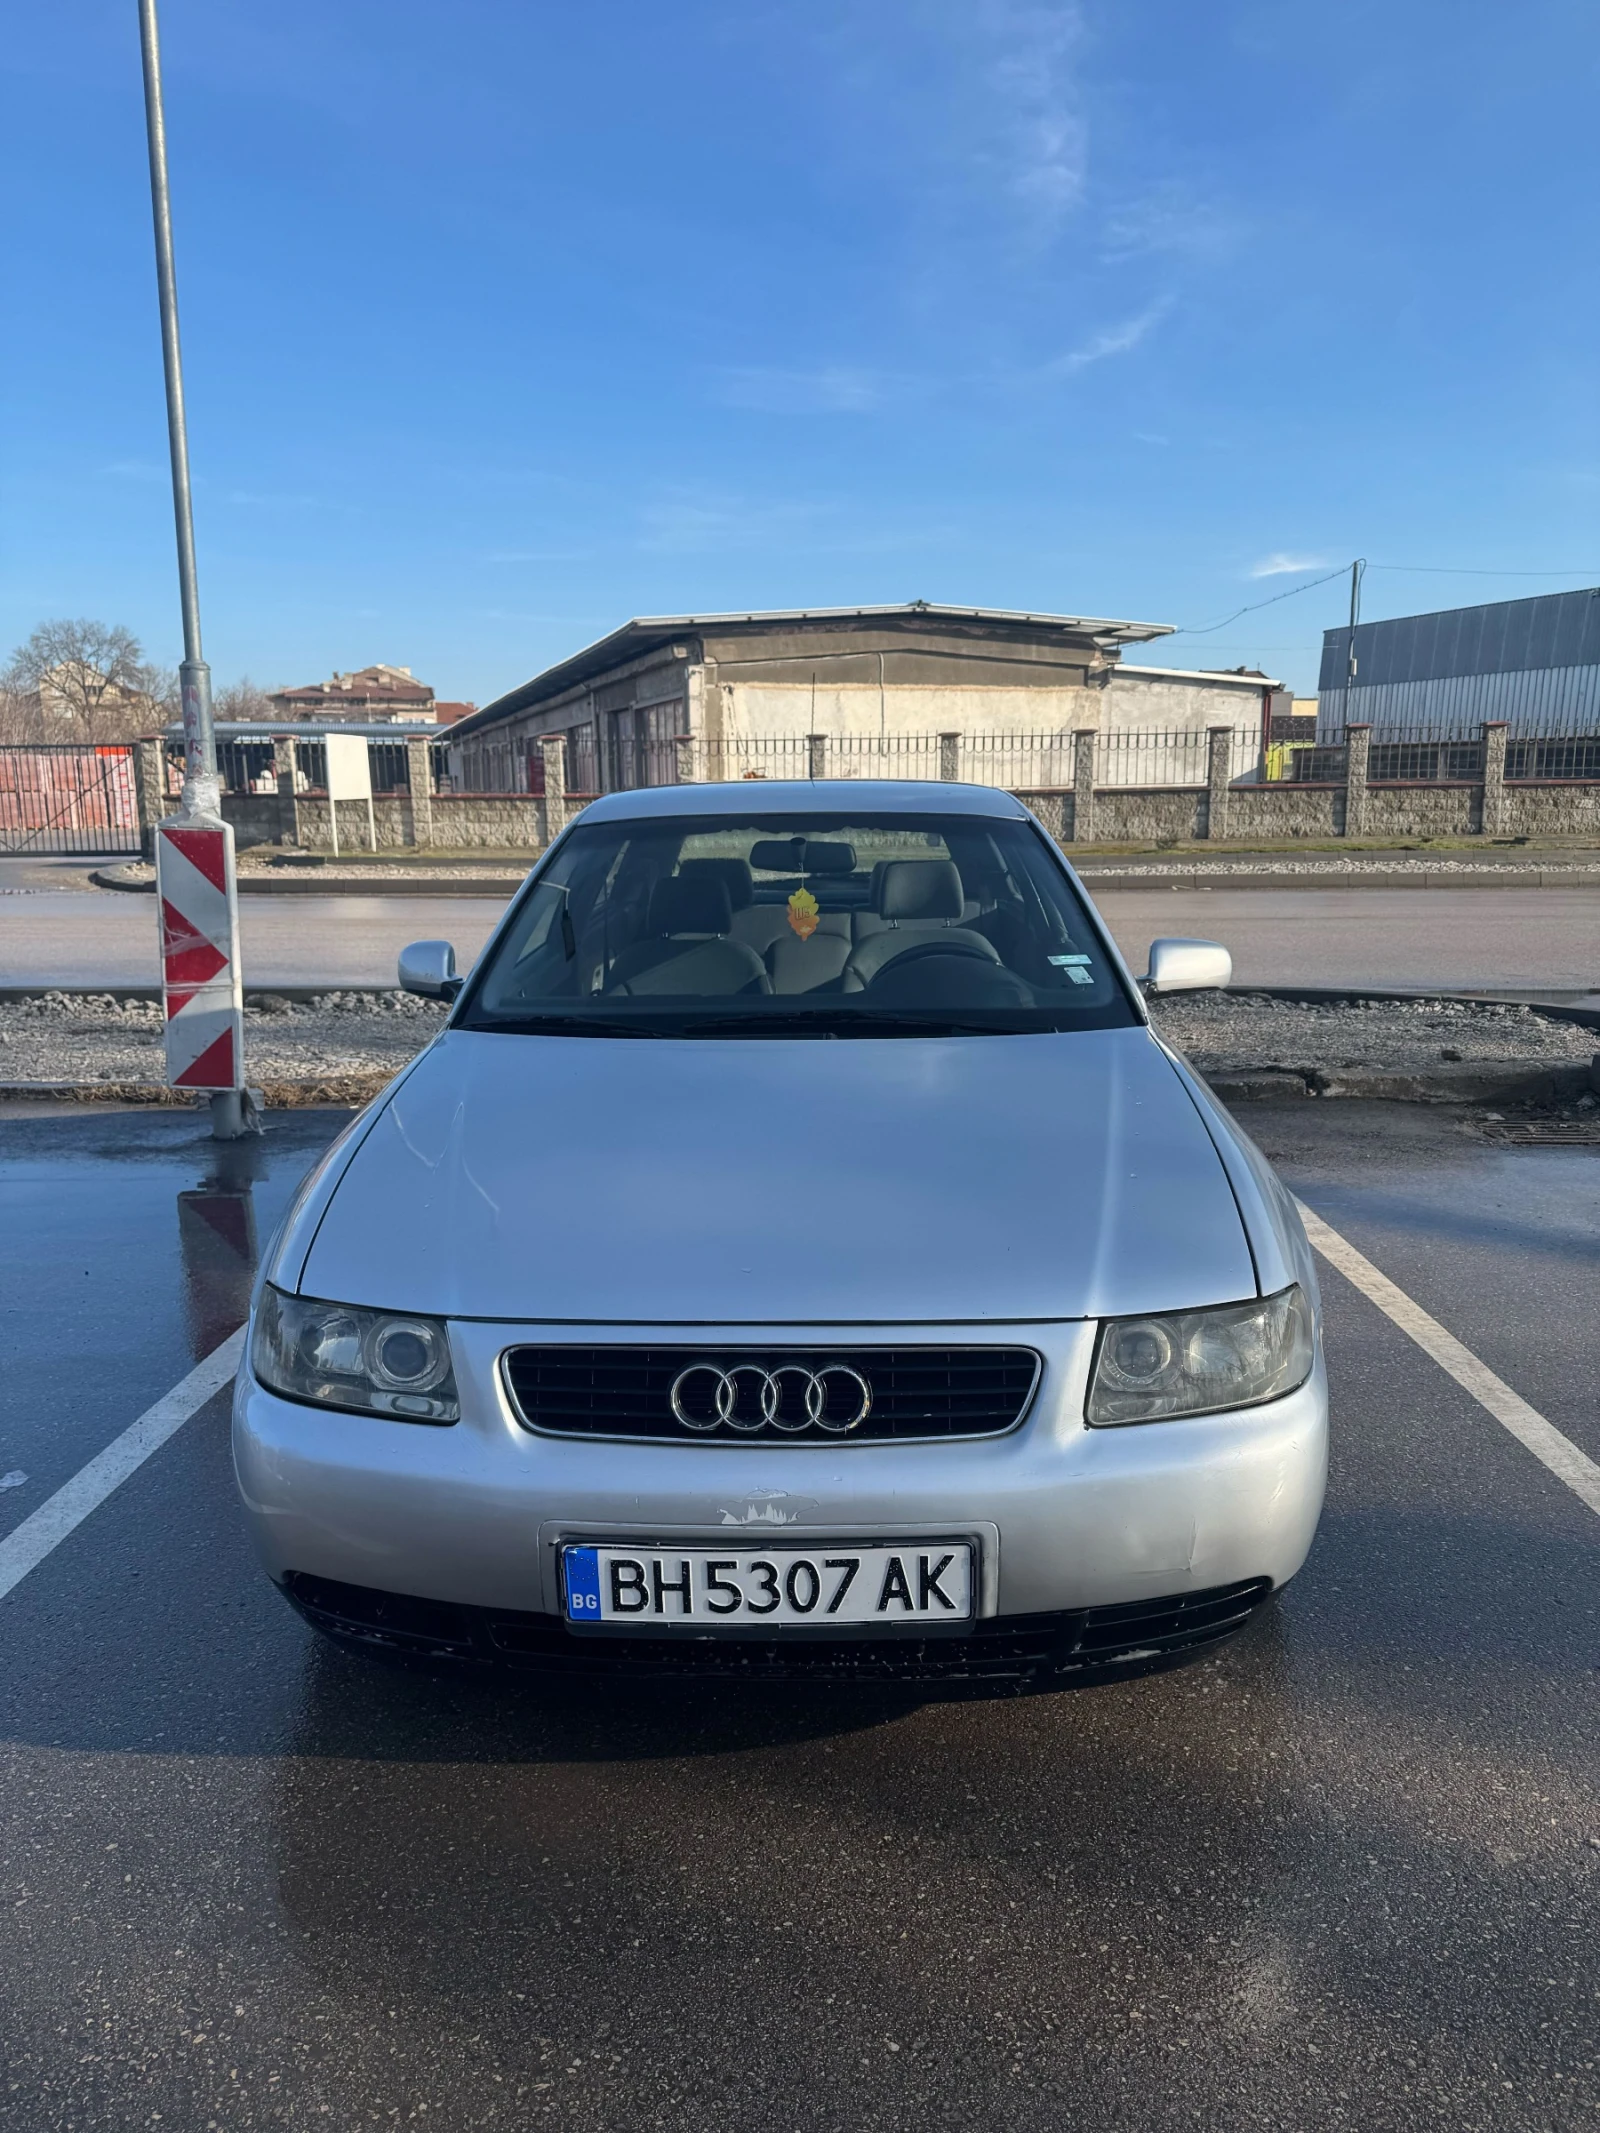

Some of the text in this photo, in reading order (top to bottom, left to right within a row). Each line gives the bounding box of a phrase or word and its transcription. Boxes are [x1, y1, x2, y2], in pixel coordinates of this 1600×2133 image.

[571, 1593, 598, 1610] BG
[705, 1557, 861, 1615] 5307
[876, 1554, 957, 1612] AK
